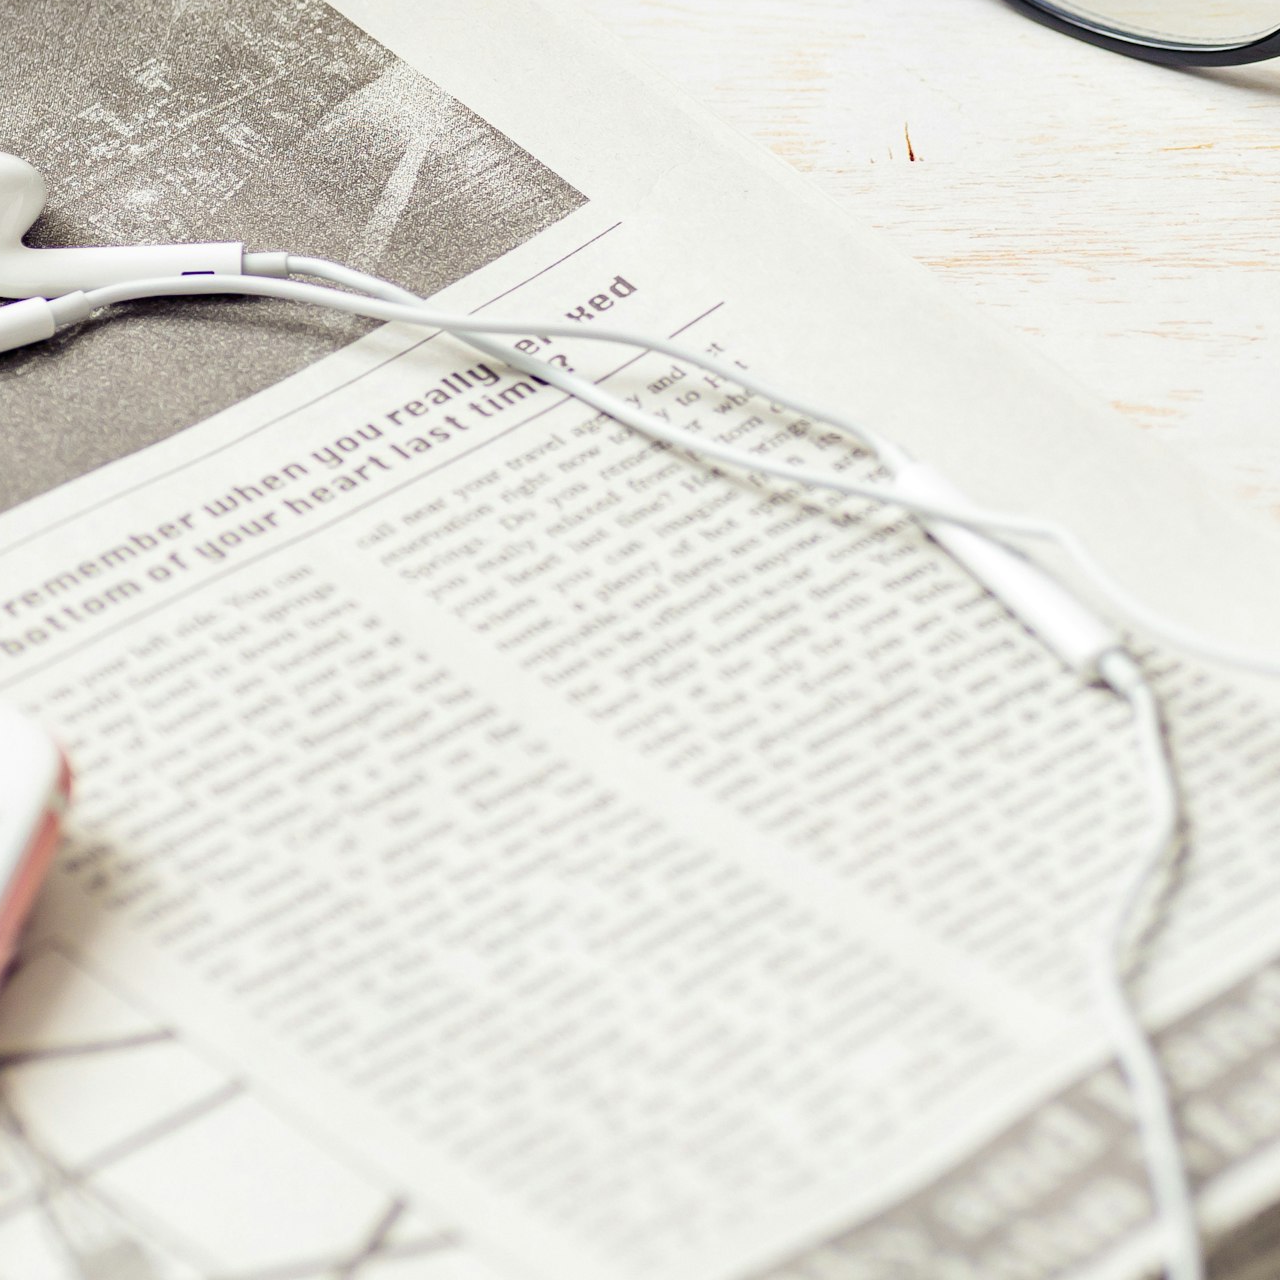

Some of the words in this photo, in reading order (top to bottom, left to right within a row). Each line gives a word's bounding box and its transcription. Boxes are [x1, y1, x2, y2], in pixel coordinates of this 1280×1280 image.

[3, 511, 195, 618] remember
[202, 459, 310, 520] when
[310, 422, 386, 471] you
[386, 362, 501, 426] really
[513, 275, 638, 356] exed
[148, 548, 191, 583] of
[191, 510, 282, 563] your
[281, 454, 393, 514] heart
[388, 413, 470, 459] last
[468, 352, 576, 419] tim?
[451, 468, 500, 502] your
[504, 433, 566, 470] travel
[647, 365, 687, 395] and
[499, 471, 551, 503] right
[557, 445, 600, 473] now
[675, 389, 701, 407] to
[703, 359, 749, 390] Ht
